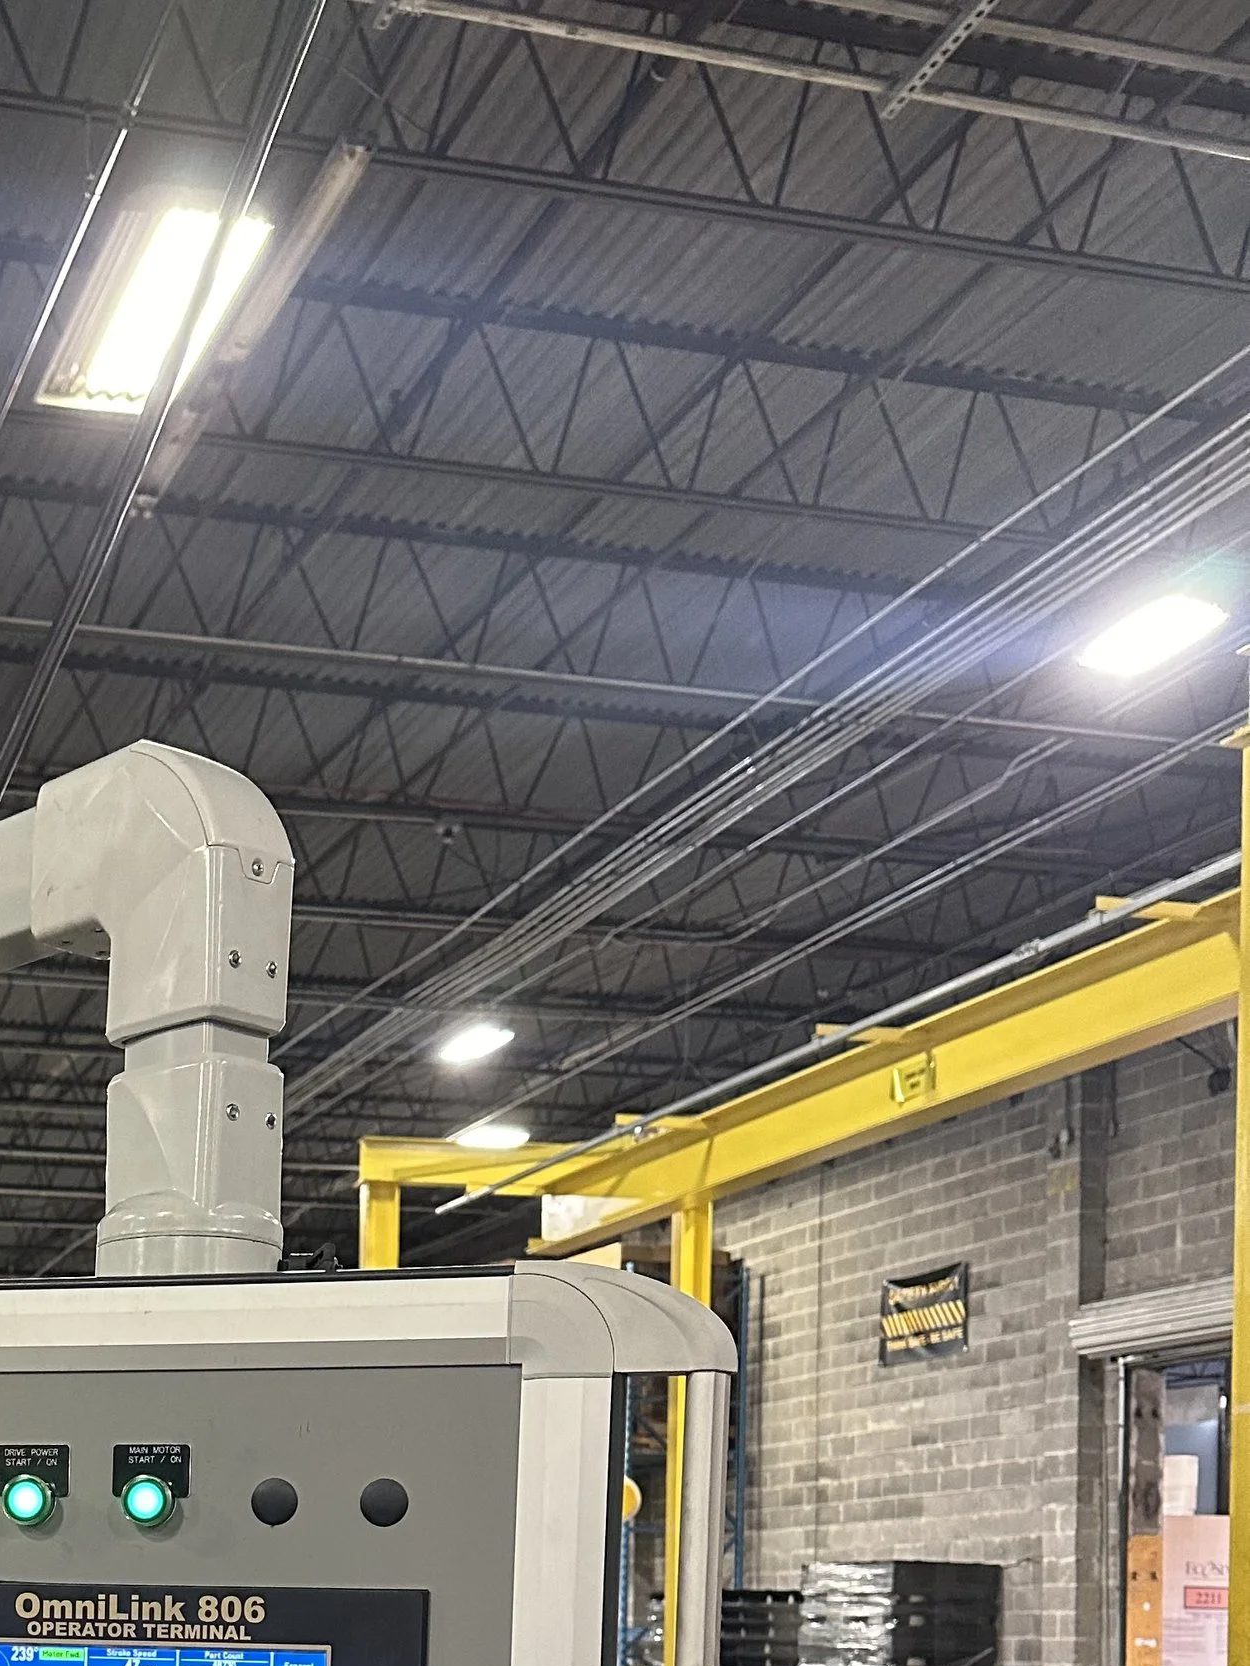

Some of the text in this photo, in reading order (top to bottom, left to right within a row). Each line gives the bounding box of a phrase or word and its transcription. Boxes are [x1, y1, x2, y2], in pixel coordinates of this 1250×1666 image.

[4, 1448, 59, 1456] DRIVE POWER
[129, 1446, 181, 1454] MAIN MOTOR
[5, 1458, 58, 1466] START / ON
[128, 1455, 155, 1463] START
[170, 1455, 182, 1463] ON
[15, 1592, 266, 1624] OmniLink 806
[26, 1621, 252, 1641] OPERATOR TERMINAL
[106, 1648, 157, 1657] Stroke Speed
[204, 1651, 244, 1660] Part Count
